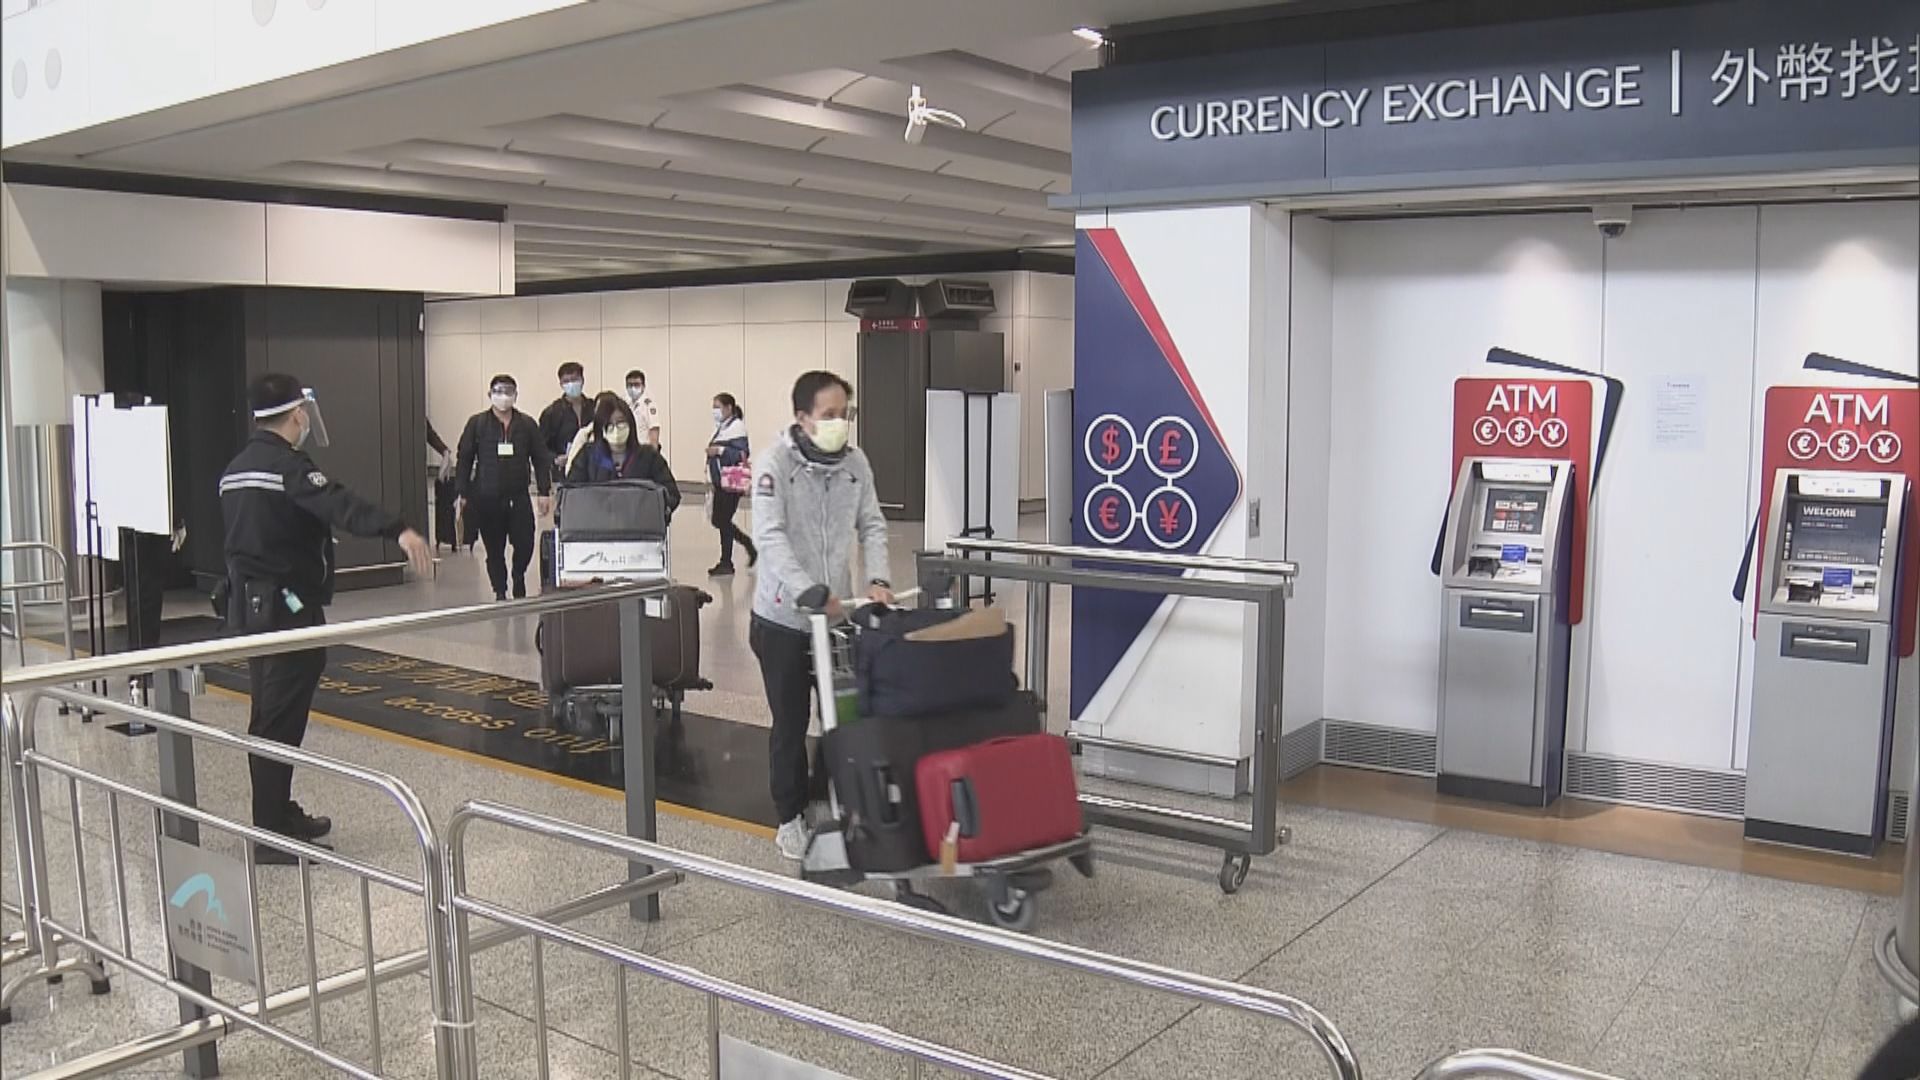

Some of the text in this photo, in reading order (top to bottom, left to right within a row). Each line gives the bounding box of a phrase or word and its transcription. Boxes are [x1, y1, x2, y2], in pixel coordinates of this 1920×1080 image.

[1150, 65, 1643, 140] CURRENCY EXCHANGE
[1486, 384, 1557, 414] ATM
[1804, 393, 1889, 426] ATM
[1102, 424, 1182, 466] $ £
[1099, 496, 1182, 535] € ¥
[1803, 505, 1857, 518] WELCOME
[384, 697, 516, 730] access
